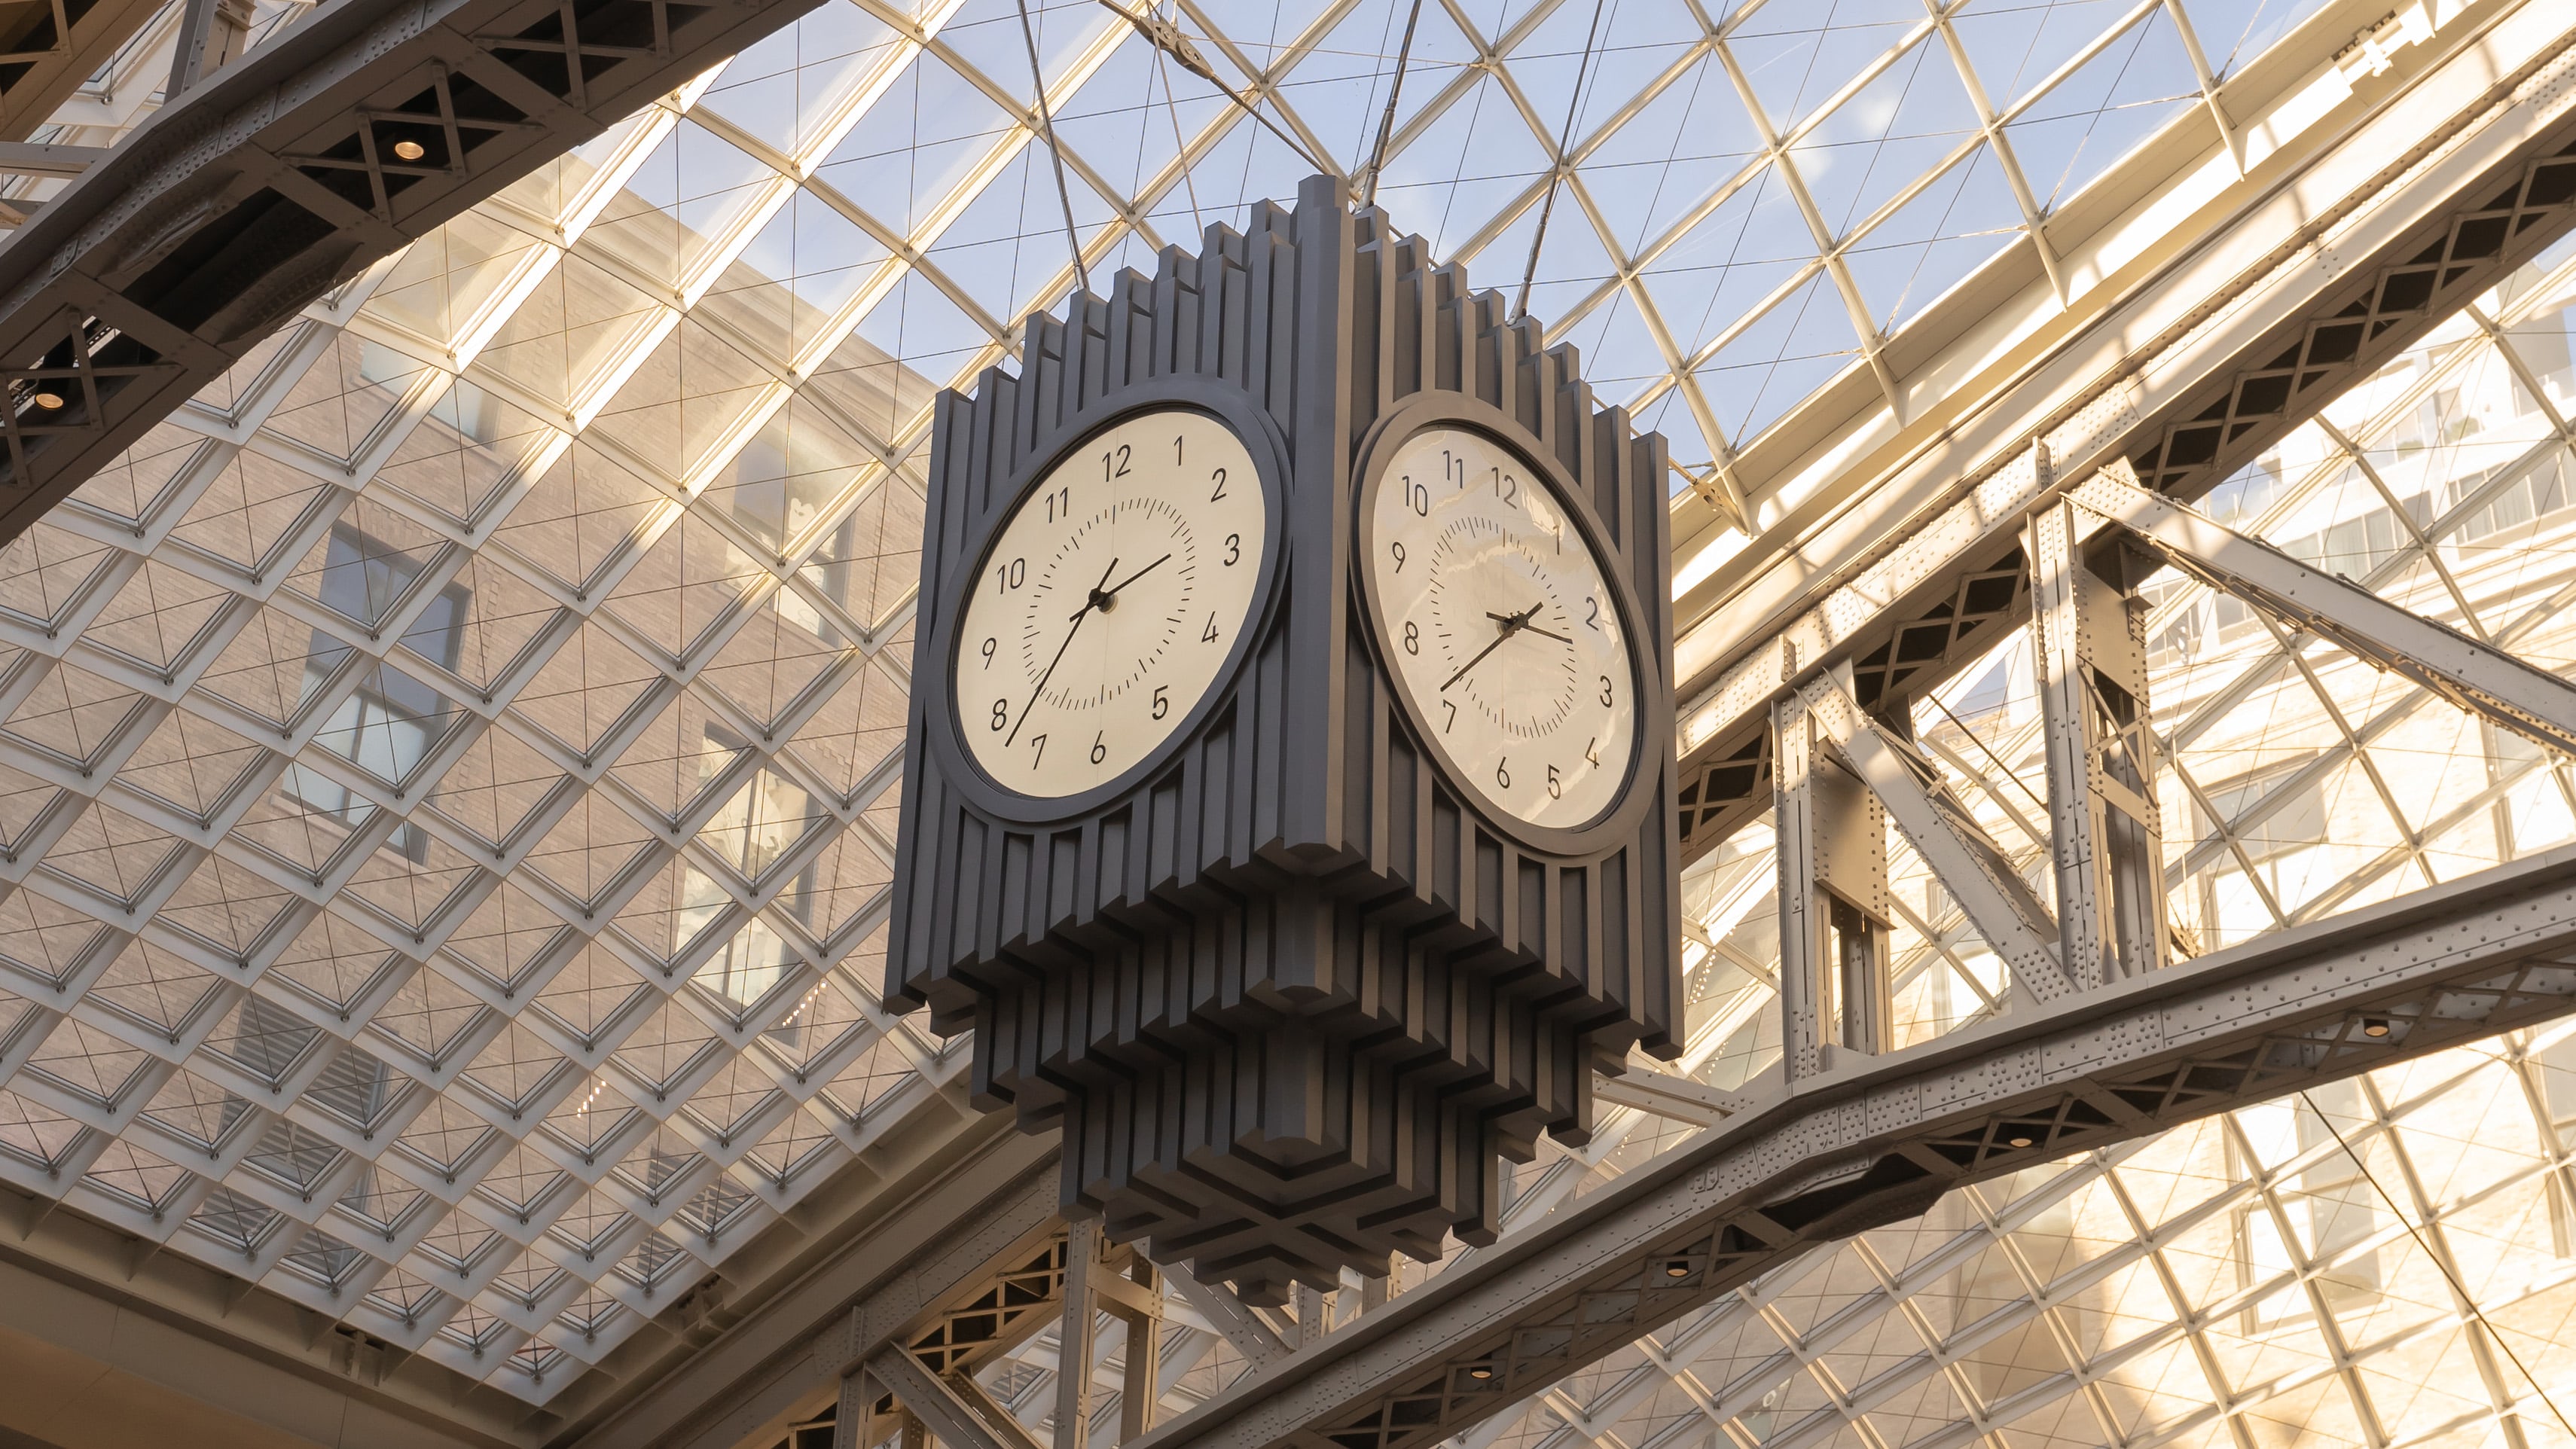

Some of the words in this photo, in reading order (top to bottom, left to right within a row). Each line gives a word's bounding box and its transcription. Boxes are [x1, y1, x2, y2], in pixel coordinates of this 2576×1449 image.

[1101, 444, 1131, 483] 12
[1174, 435, 1183, 467] 1
[1210, 467, 1227, 503] 2
[1442, 450, 1463, 490] 11
[1491, 466, 1517, 510] 12
[1045, 486, 1069, 524] 11
[1402, 475, 1428, 517] 10
[1223, 533, 1240, 567] 3
[1392, 541, 1406, 575] 9
[1552, 524, 1561, 556] 1
[997, 557, 1026, 595] 10
[1201, 610, 1219, 644] 4
[1585, 596, 1599, 632] 2
[981, 637, 997, 671] 9
[1404, 621, 1419, 656] 8
[1152, 684, 1169, 721] 5
[1599, 675, 1613, 709] 3
[990, 698, 1008, 732] 8
[1442, 698, 1457, 734] 7
[1031, 733, 1048, 770] 7
[1090, 729, 1106, 765] 6
[1585, 737, 1600, 770] 4
[1497, 755, 1511, 789] 6
[1547, 764, 1561, 801] 5
